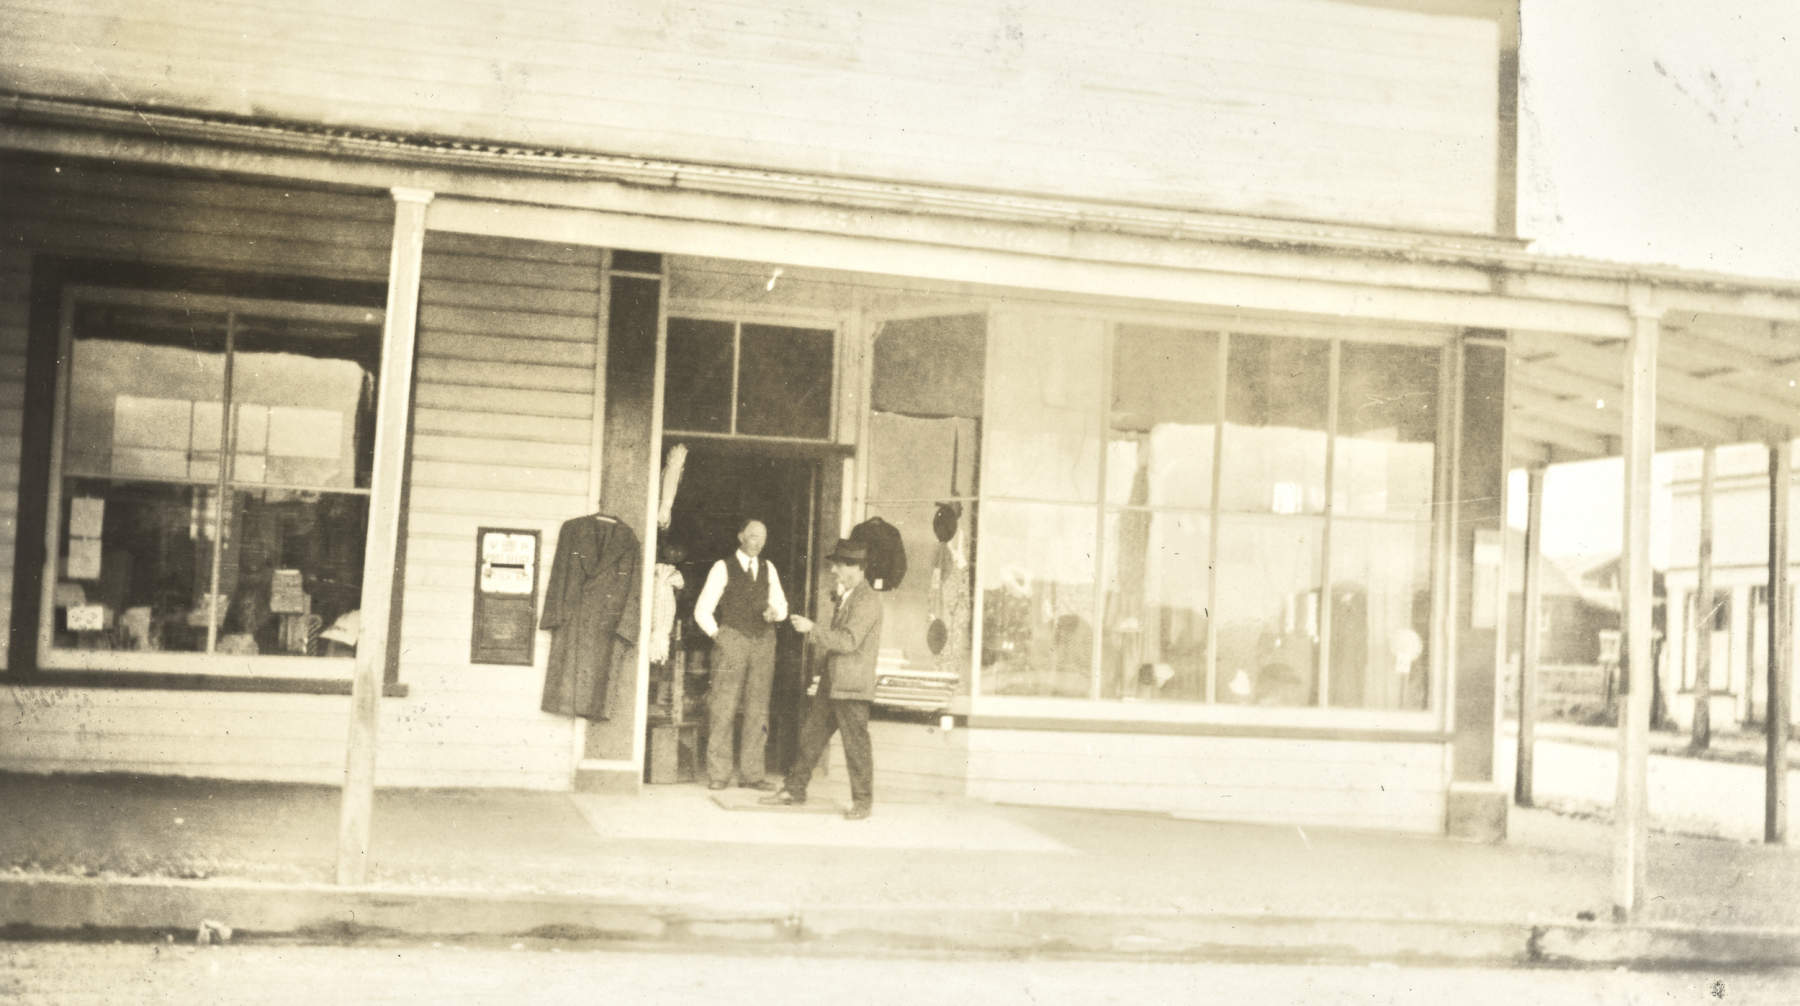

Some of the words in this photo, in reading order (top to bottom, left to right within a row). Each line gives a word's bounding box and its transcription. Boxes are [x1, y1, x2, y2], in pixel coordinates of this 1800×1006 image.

[485, 553, 504, 563] POST
[506, 554, 530, 564] OFFICE
[485, 572, 511, 581] TTER
